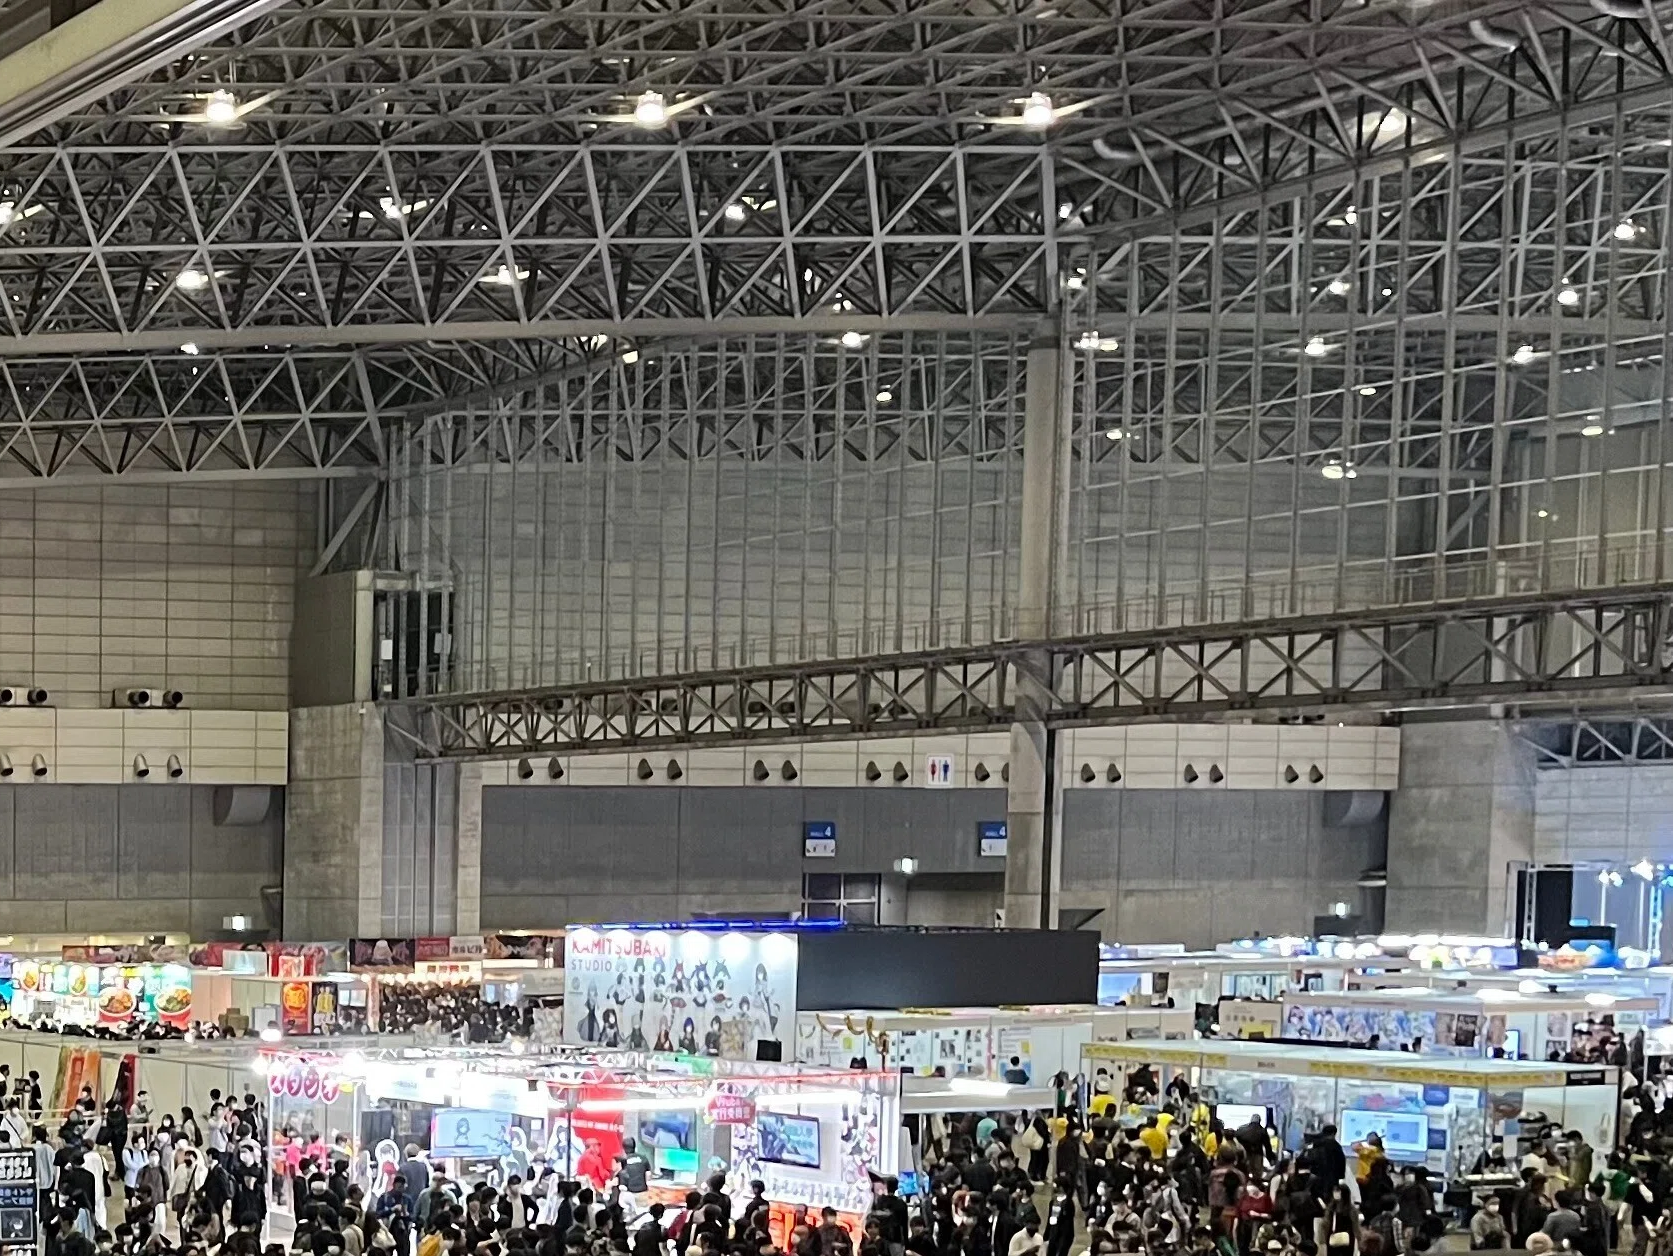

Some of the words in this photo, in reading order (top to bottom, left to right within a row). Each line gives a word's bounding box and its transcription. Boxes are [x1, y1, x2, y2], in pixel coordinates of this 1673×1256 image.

[824, 826, 832, 838] 4
[998, 825, 1006, 837] 4
[571, 958, 613, 972] STUDIO
